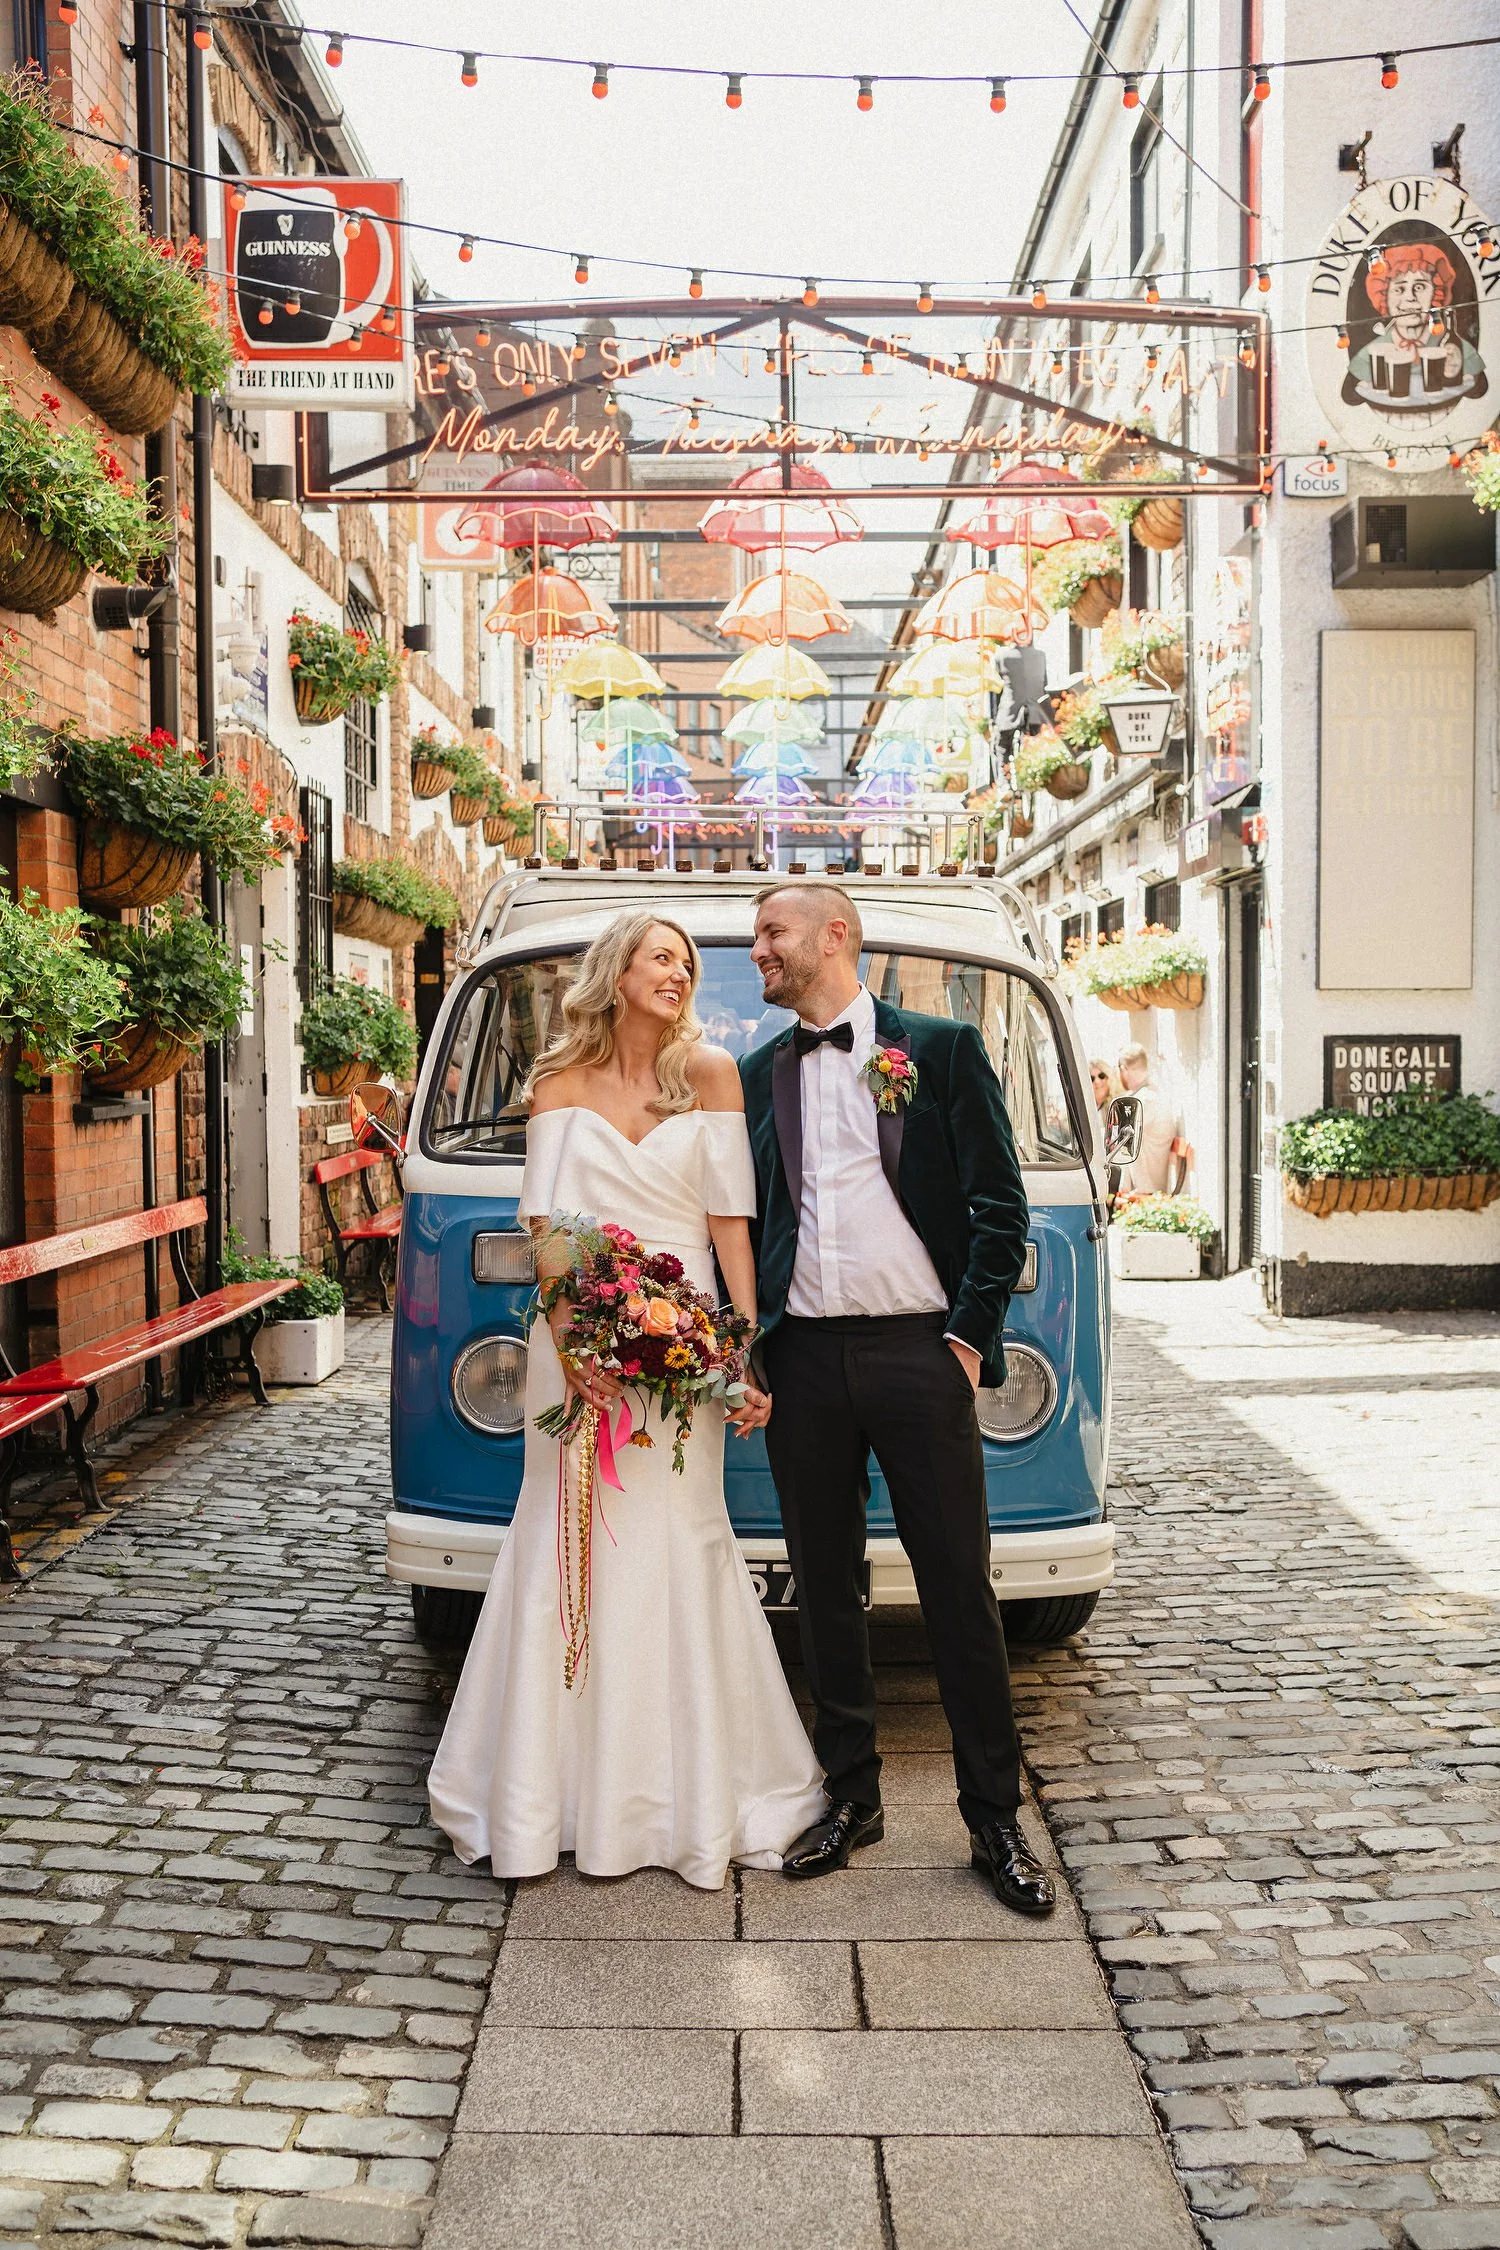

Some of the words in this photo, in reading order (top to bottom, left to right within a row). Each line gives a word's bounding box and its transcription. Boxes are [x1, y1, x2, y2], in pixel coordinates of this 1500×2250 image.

[245, 240, 331, 257] GUINNESS
[1311, 202, 1380, 297] DUKE
[1389, 181, 1433, 212] OF
[493, 339, 577, 388] ONLY
[236, 369, 266, 388] THE
[271, 370, 326, 388] FRIEND
[330, 372, 349, 389] AT
[354, 372, 395, 390] HAND
[1294, 473, 1340, 491] focus
[1350, 1071, 1436, 1093] SQUARE
